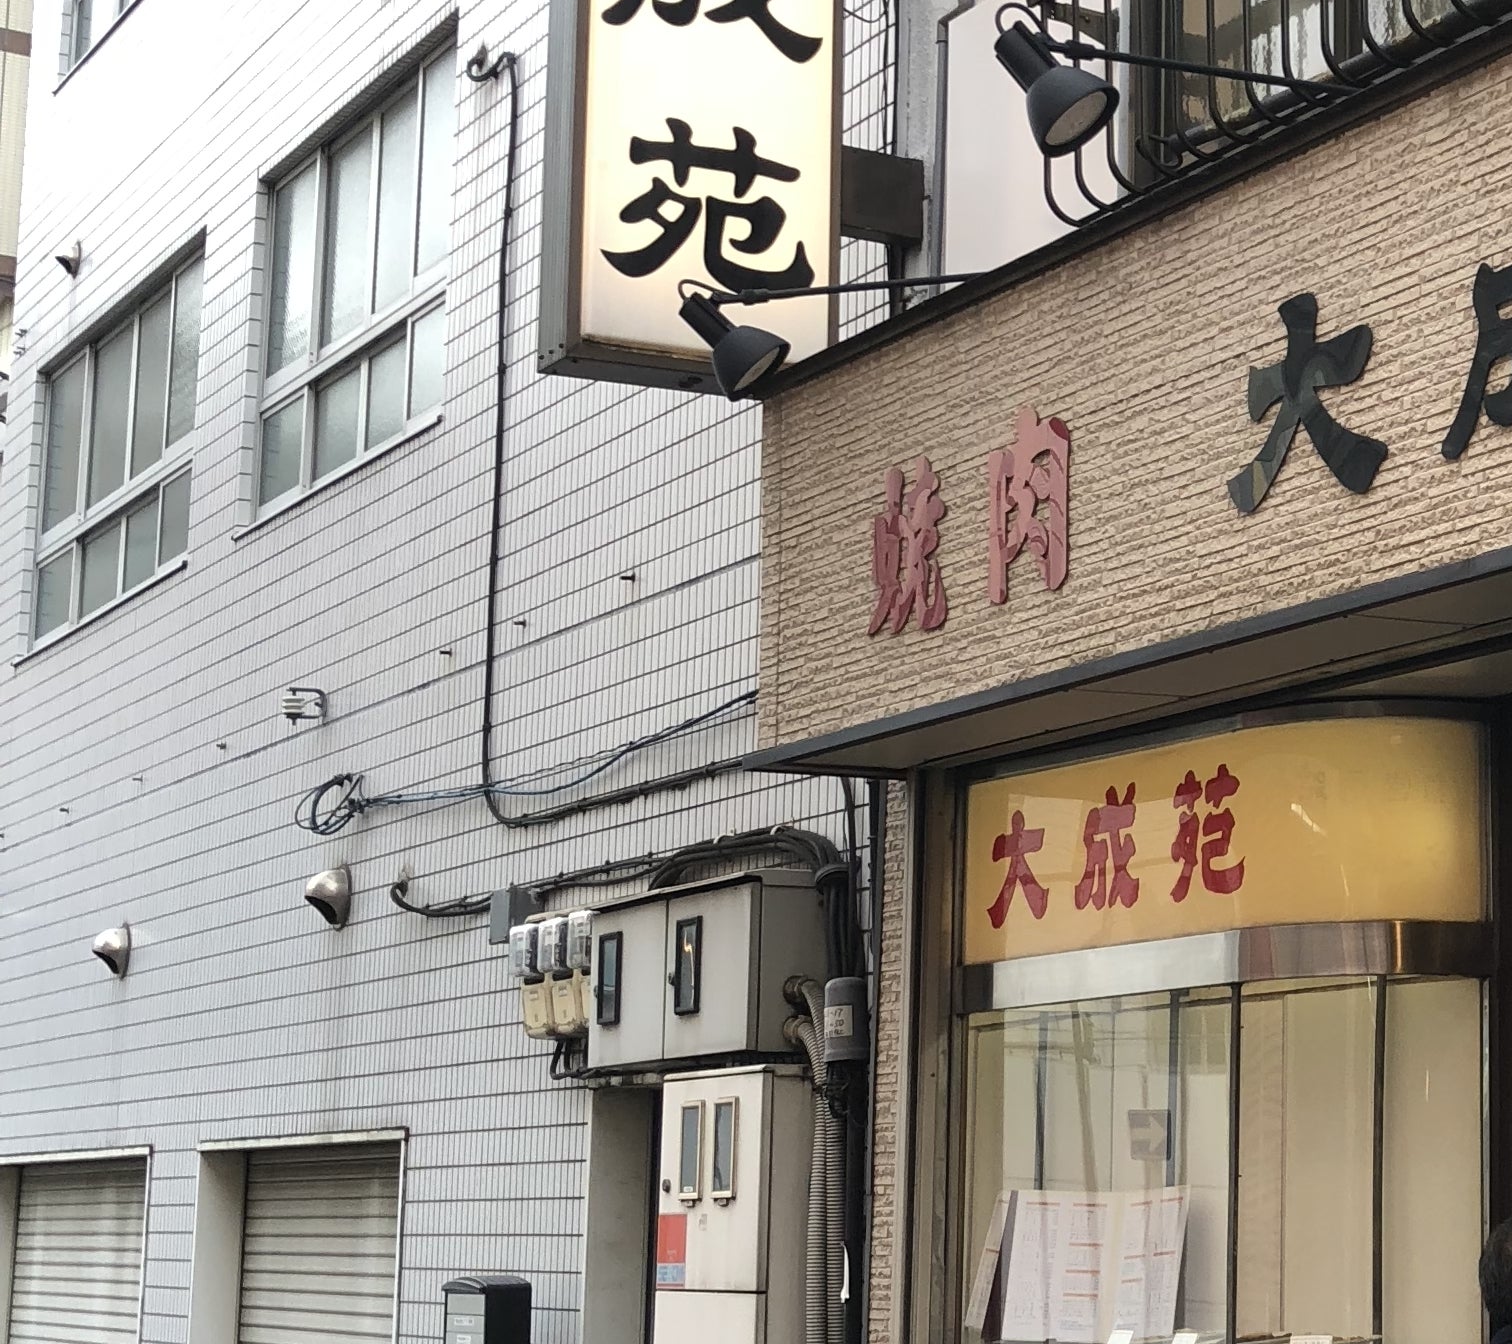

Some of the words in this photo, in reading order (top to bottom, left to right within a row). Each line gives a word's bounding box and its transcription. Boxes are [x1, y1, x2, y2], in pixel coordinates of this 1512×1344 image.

[866, 406, 1072, 638] 焼肉
[987, 763, 1246, 929] 大成苑
